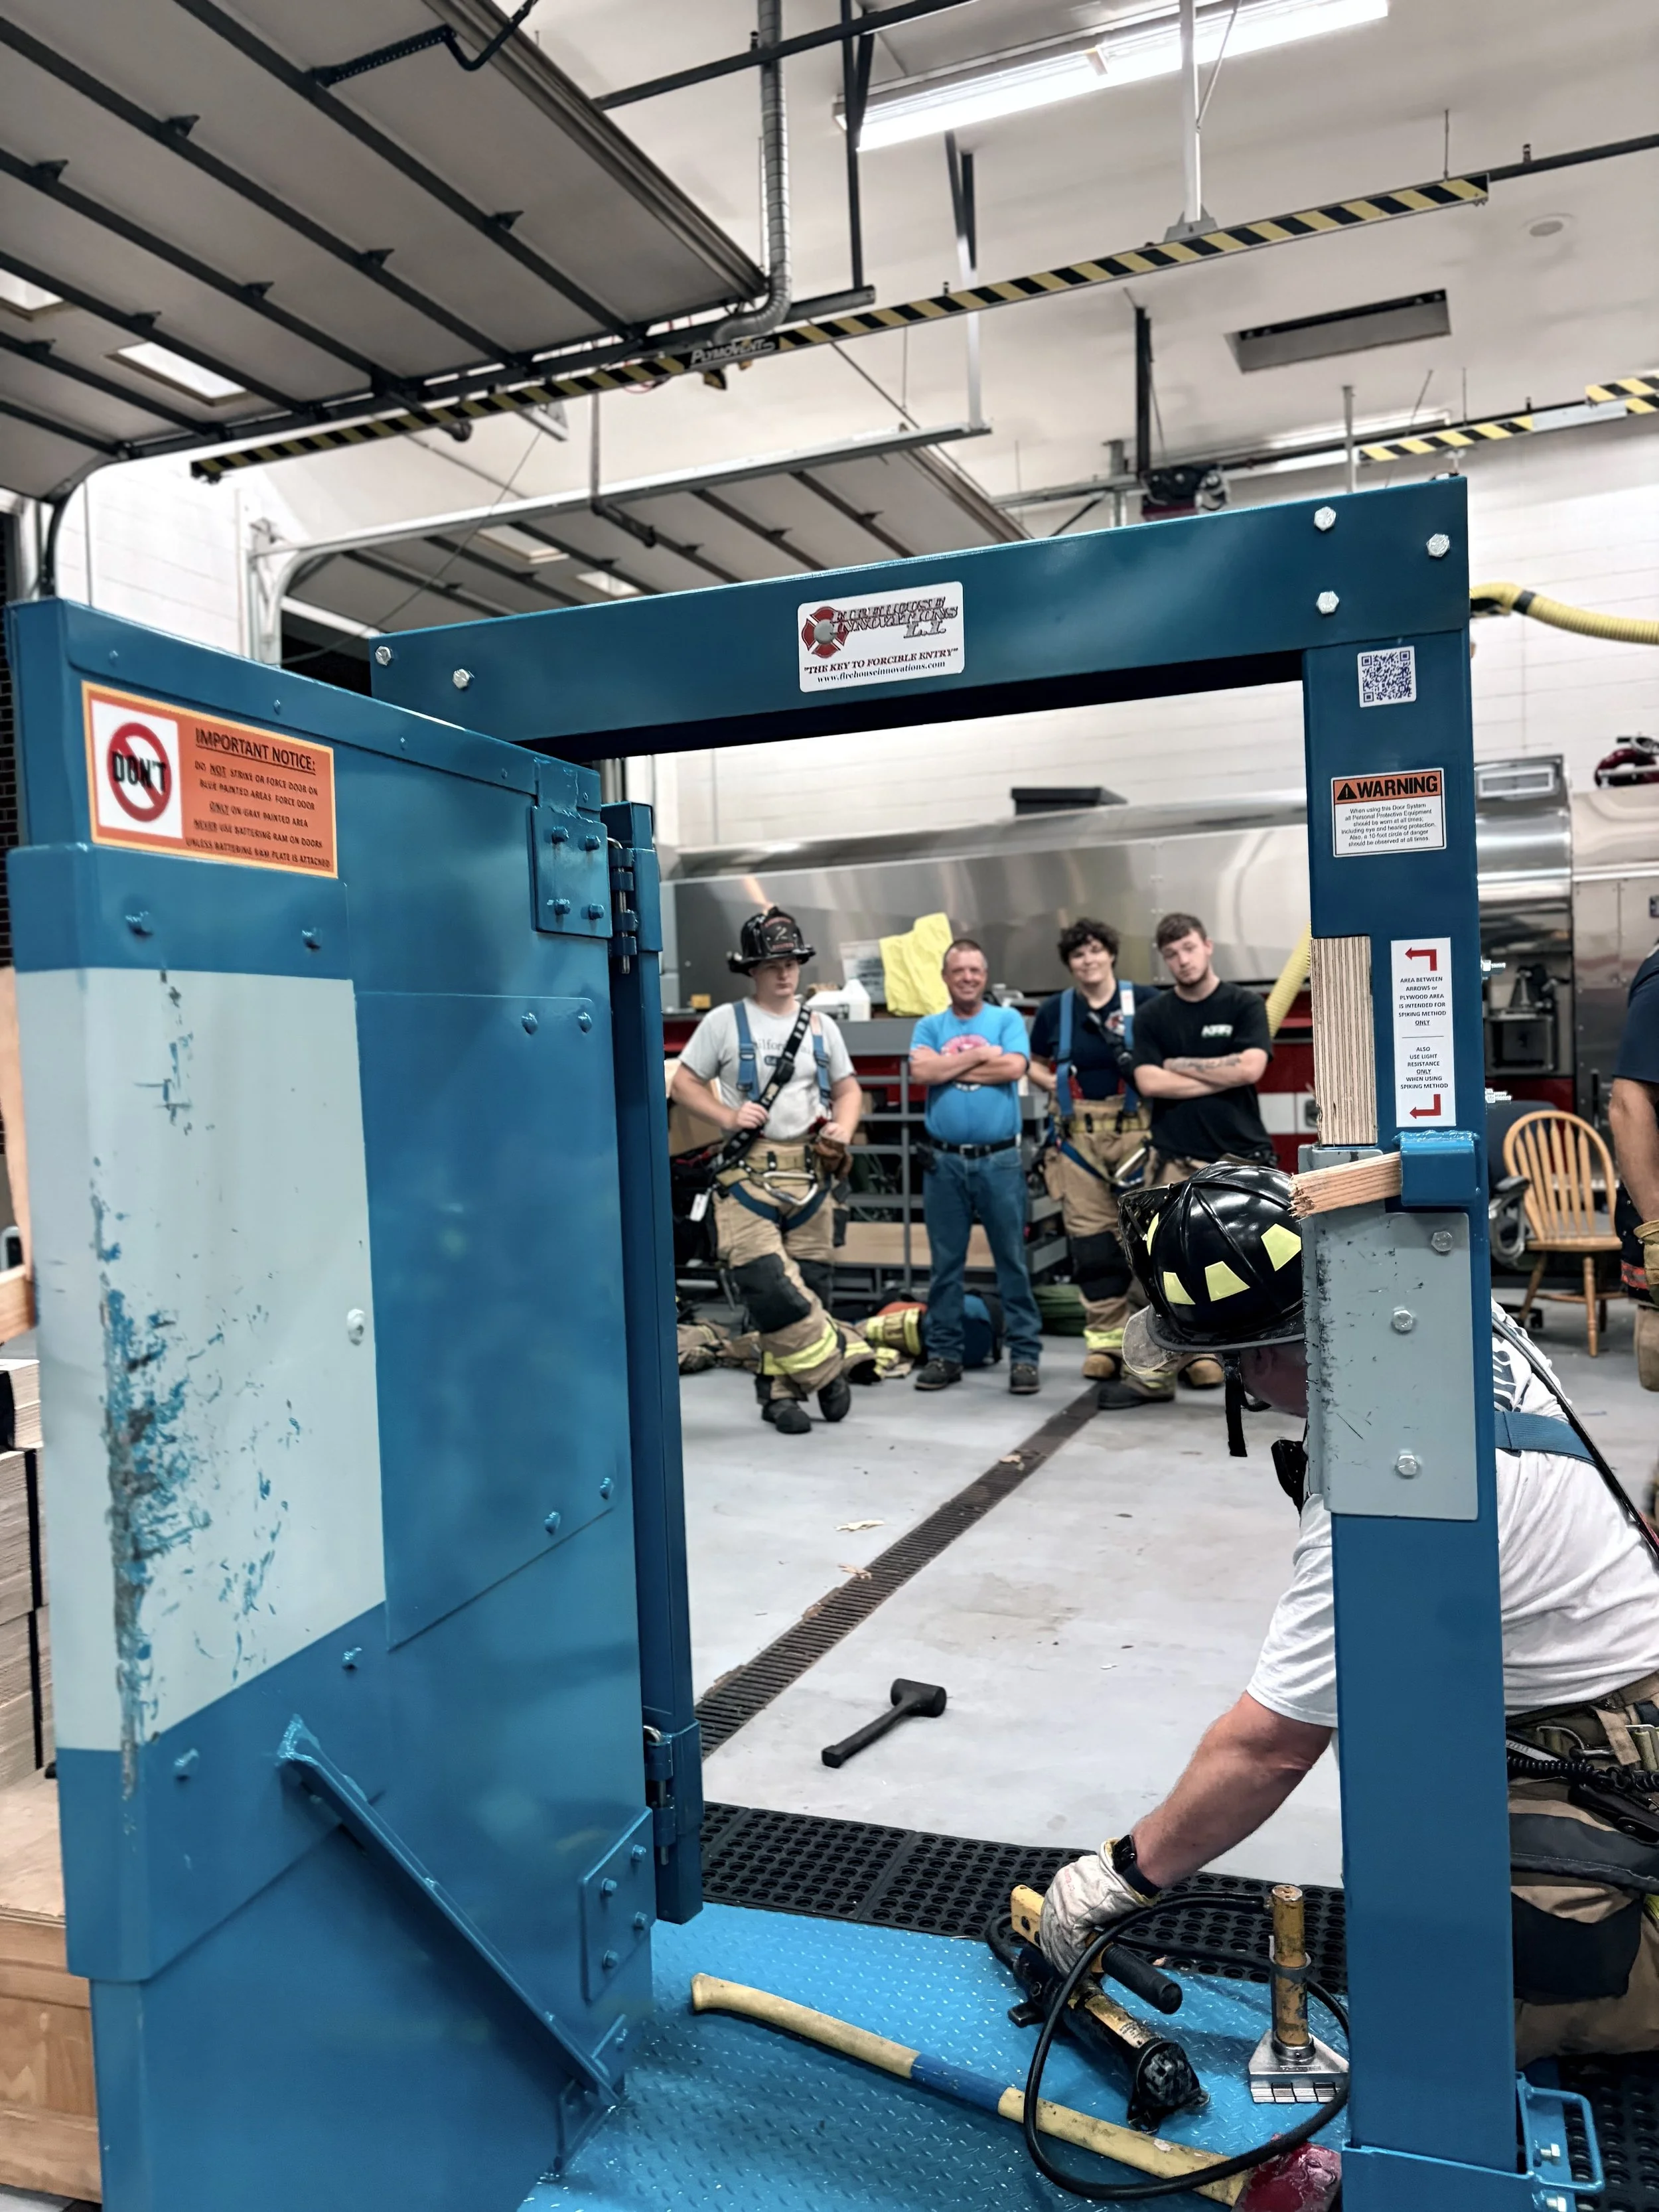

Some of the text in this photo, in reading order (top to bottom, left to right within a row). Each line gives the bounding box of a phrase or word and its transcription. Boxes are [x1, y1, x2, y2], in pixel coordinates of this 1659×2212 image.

[818, 662, 945, 682] www.firehouseinnovations.com
[852, 660, 865, 668] TO
[867, 654, 917, 666] FORCIBLE
[195, 727, 315, 771] IMPORTANT NOTICE:
[112, 751, 167, 792] DON'T
[210, 764, 226, 776] NOT
[230, 770, 253, 781] STRIKE
[255, 774, 264, 783] OR
[267, 777, 286, 788] FORCE
[289, 782, 307, 793] DOOR
[200, 779, 216, 790] BLUE
[220, 783, 249, 796] PAINTED
[275, 795, 295, 806] FORCE
[297, 801, 315, 810] DOOR
[1357, 776, 1437, 798] WARNING
[210, 801, 229, 814] ONLY
[232, 806, 241, 815] ON
[244, 808, 260, 818] GRAY
[263, 812, 290, 824] PAINTED
[194, 819, 218, 832] NEVER
[220, 824, 232, 833] USE
[235, 826, 271, 840] BATTERING
[273, 834, 287, 842] RAM
[301, 838, 323, 848] DOORS
[185, 837, 212, 848] UNLESS
[214, 842, 252, 855] BATTERING
[255, 848, 269, 857] RAM
[272, 851, 290, 861] PLATE
[300, 855, 330, 867] ATTACHED
[775, 926, 788, 940] 2
